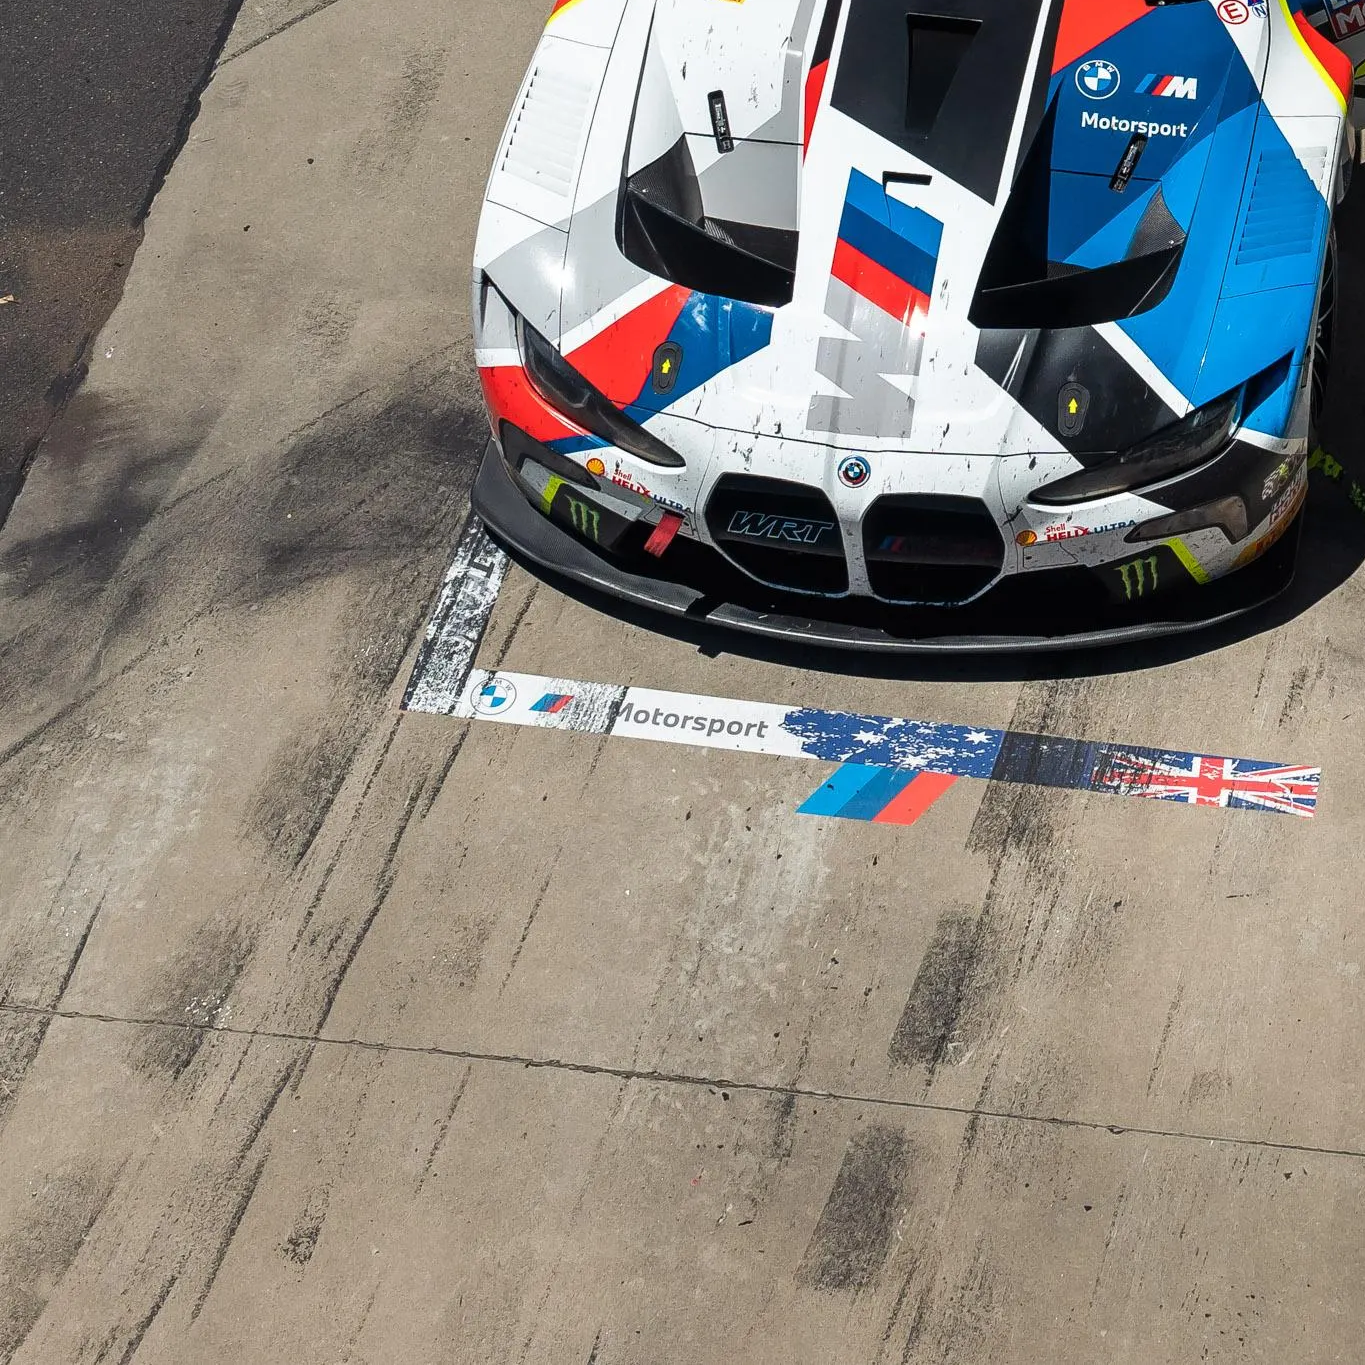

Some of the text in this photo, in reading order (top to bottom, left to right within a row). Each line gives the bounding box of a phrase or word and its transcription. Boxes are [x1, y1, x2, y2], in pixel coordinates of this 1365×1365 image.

[1083, 61, 1115, 73] BMW
[1081, 112, 1188, 137] Motorsport
[613, 468, 633, 481] Shell
[612, 476, 695, 513] HELIX ULTRA
[727, 511, 835, 544] WRT
[1045, 523, 1066, 533] Shell
[1046, 519, 1138, 542] HELIX ULTRA
[615, 697, 769, 739] Motorsport
